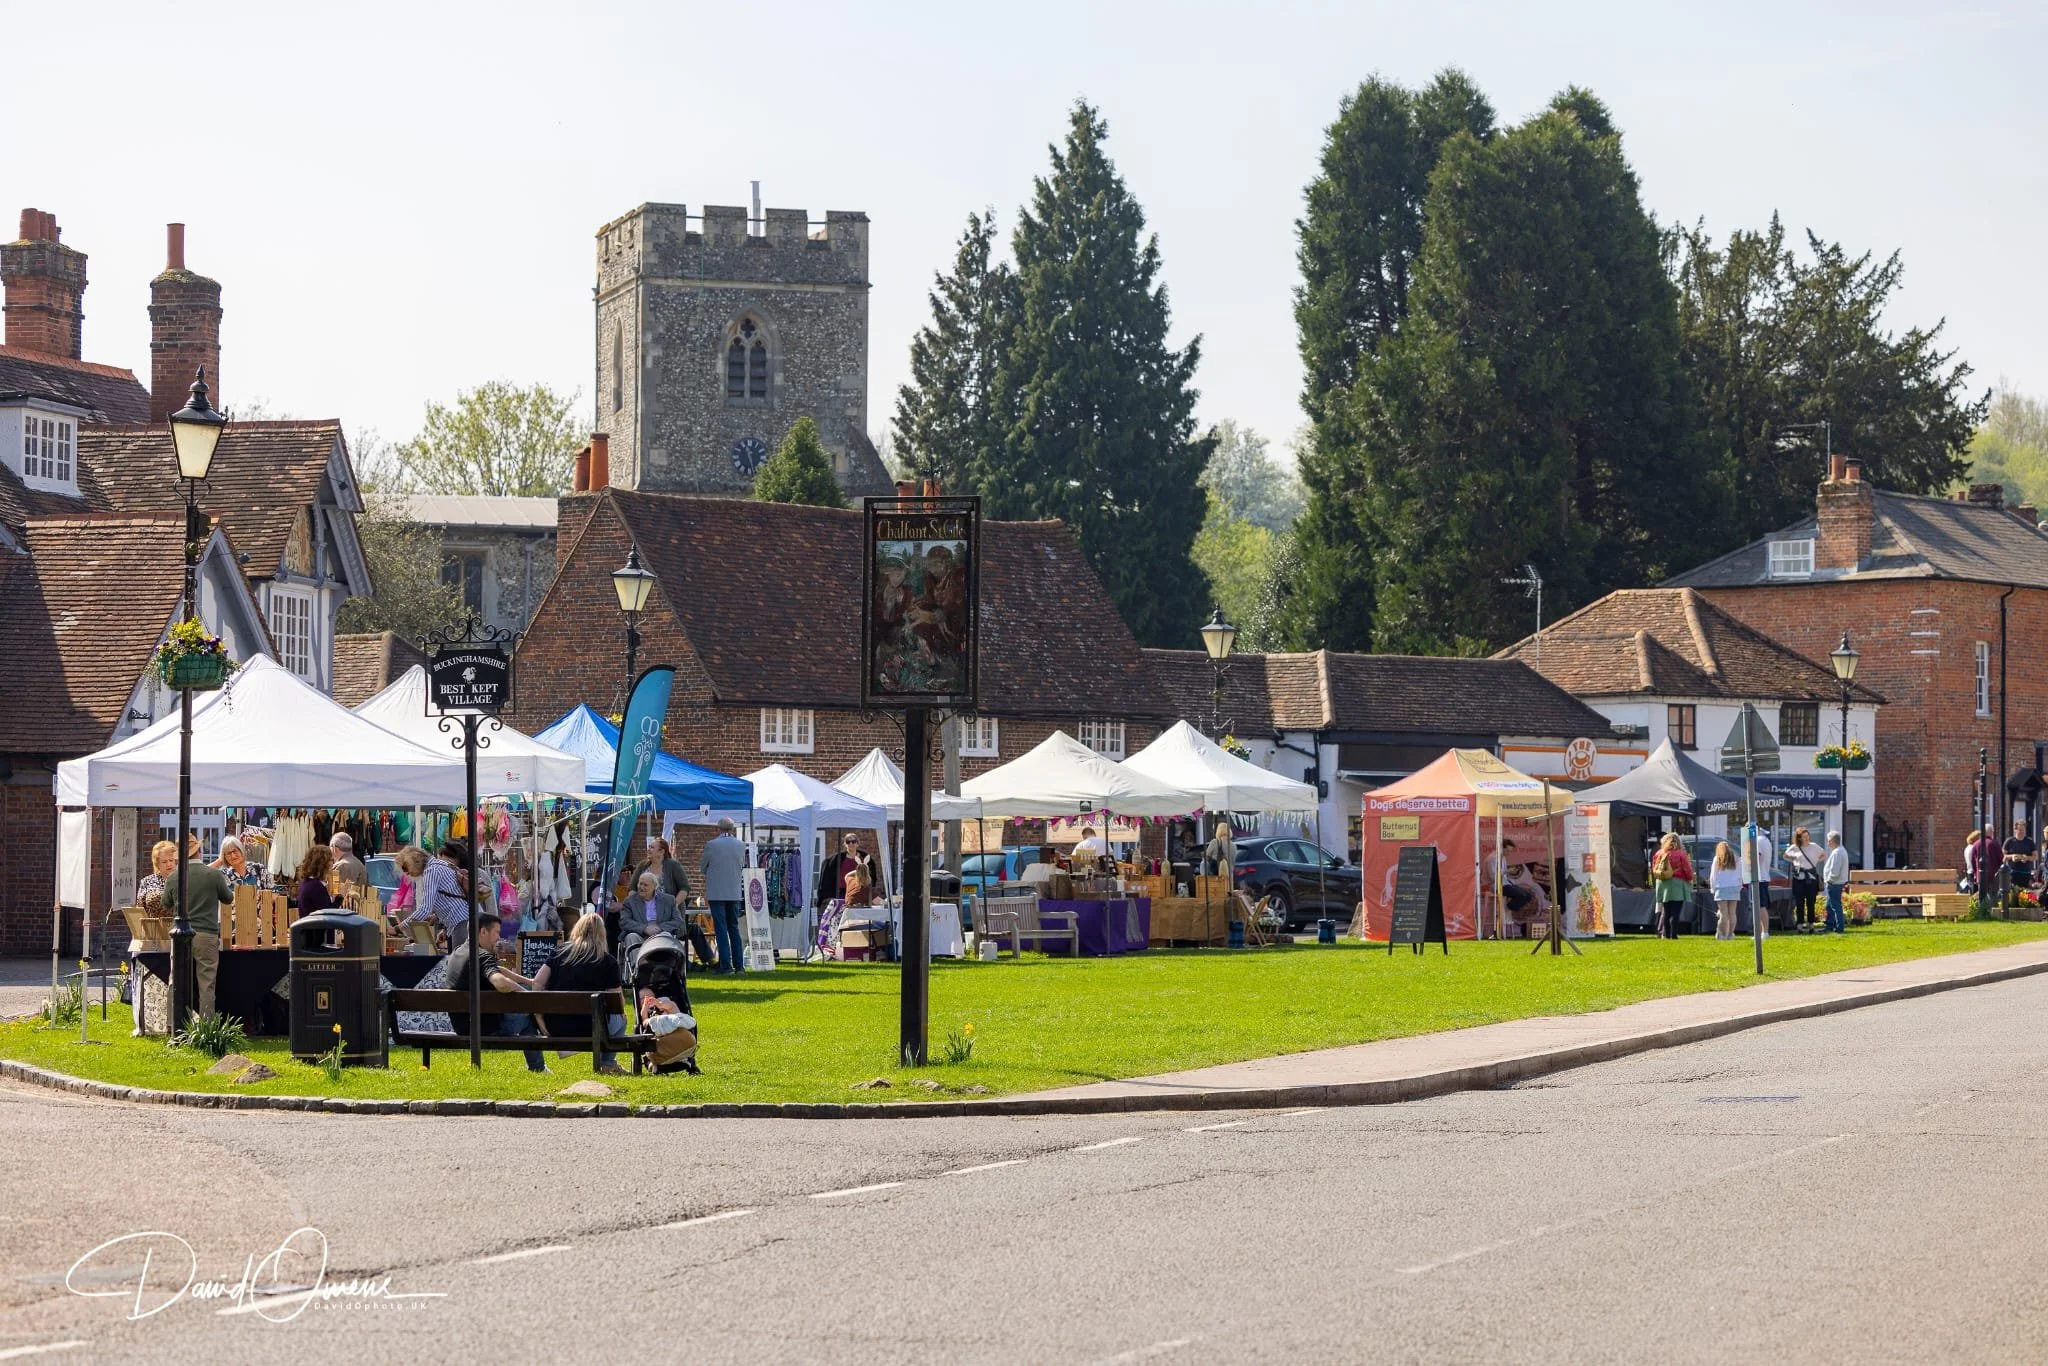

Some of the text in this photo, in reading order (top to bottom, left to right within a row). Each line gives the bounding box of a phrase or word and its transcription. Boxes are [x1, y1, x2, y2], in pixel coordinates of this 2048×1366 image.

[877, 519, 927, 540] Chalfont
[433, 655, 507, 672] BUCKINGHAMSHIRE
[440, 683, 499, 694] BEST KEPT
[448, 694, 493, 704] VILLAGE
[1570, 739, 1592, 751] THE
[1569, 767, 1592, 779] DELI
[1370, 799, 1467, 812] Dogs deserve better
[1754, 798, 1785, 809] OODCRAFT
[1382, 822, 1417, 831] Butternut
